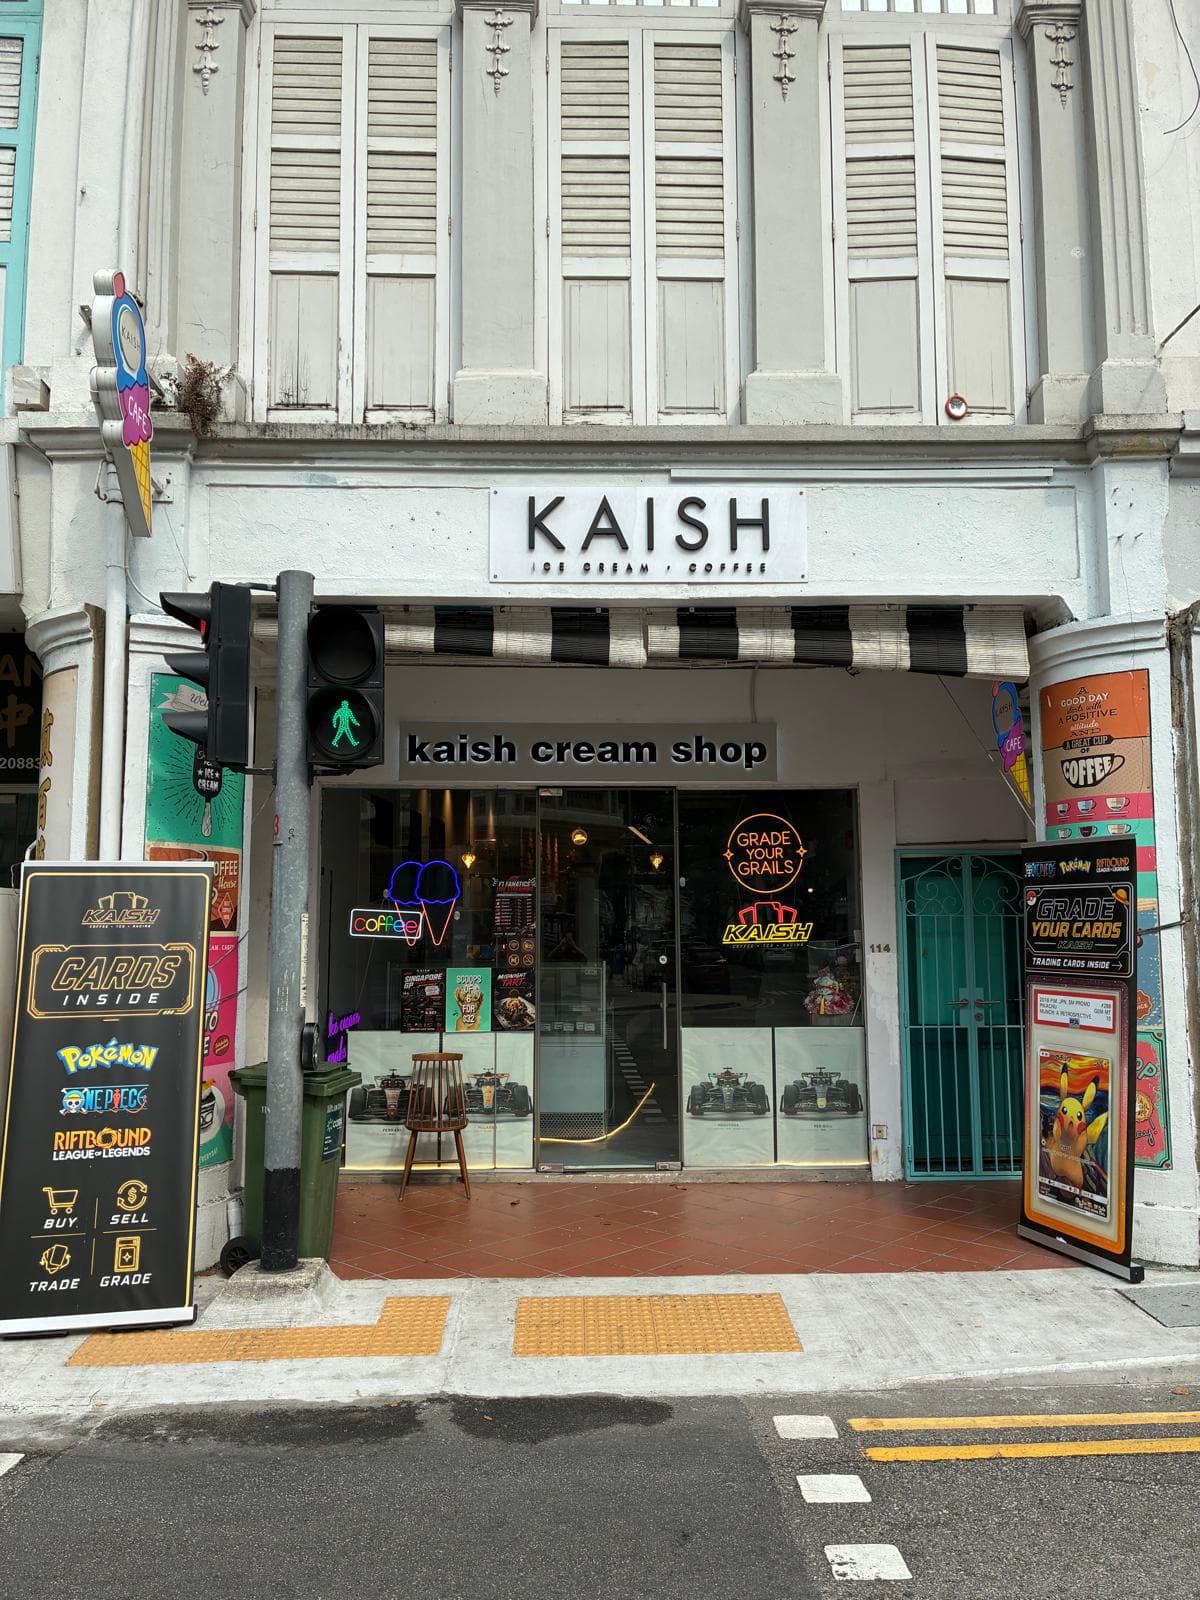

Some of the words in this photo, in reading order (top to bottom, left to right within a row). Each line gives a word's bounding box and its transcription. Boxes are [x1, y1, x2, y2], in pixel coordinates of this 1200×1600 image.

[128, 395, 147, 434] CAFE
[527, 495, 770, 551] KAISH
[532, 562, 564, 573] ICE
[583, 562, 649, 573] CREAM
[688, 562, 766, 573] COFFEE
[1061, 696, 1086, 708] GOOD
[1088, 692, 1109, 702] DAY
[1066, 708, 1118, 723] POSITIVE
[1006, 737, 1022, 752] CAFE
[1071, 737, 1092, 748] GREAT
[1093, 735, 1108, 745] CUP
[407, 734, 516, 763] kaish
[531, 740, 657, 763] cream
[671, 735, 768, 769] shop
[1062, 755, 1112, 786] COFFEE
[197, 778, 219, 792] CREAM
[737, 831, 791, 847] GRADE
[746, 847, 784, 859] YOUR
[214, 860, 238, 876] OFFEE
[738, 860, 794, 876] GRAILS
[82, 908, 160, 922] KAISH
[1036, 897, 1117, 920] GRADE
[354, 914, 418, 934] coffee
[1032, 921, 1070, 938] YOUR
[1072, 921, 1122, 939] CARDS
[723, 922, 814, 942] KAISH
[869, 943, 891, 953] 114
[1032, 957, 1061, 967] TRADING
[1063, 959, 1086, 968] CARDS
[1087, 960, 1111, 969] INSIDE
[51, 955, 181, 991] CARDS
[404, 972, 443, 983] SINGAPORE
[456, 974, 482, 985] SCOOPS
[63, 992, 160, 1006] INSIDE
[462, 1004, 476, 1014] FOR
[204, 1011, 219, 1031] TO
[463, 1014, 476, 1024] $32
[1136, 1057, 1157, 1080] OP
[54, 1127, 151, 1150] RIFTBOUND
[53, 1149, 95, 1161] LEAGUE
[102, 1147, 151, 1158] LEGENDS
[43, 1217, 78, 1229] BUY
[109, 1213, 149, 1225] SELL
[29, 1278, 80, 1292] TRADE
[100, 1273, 152, 1287] GRADE
